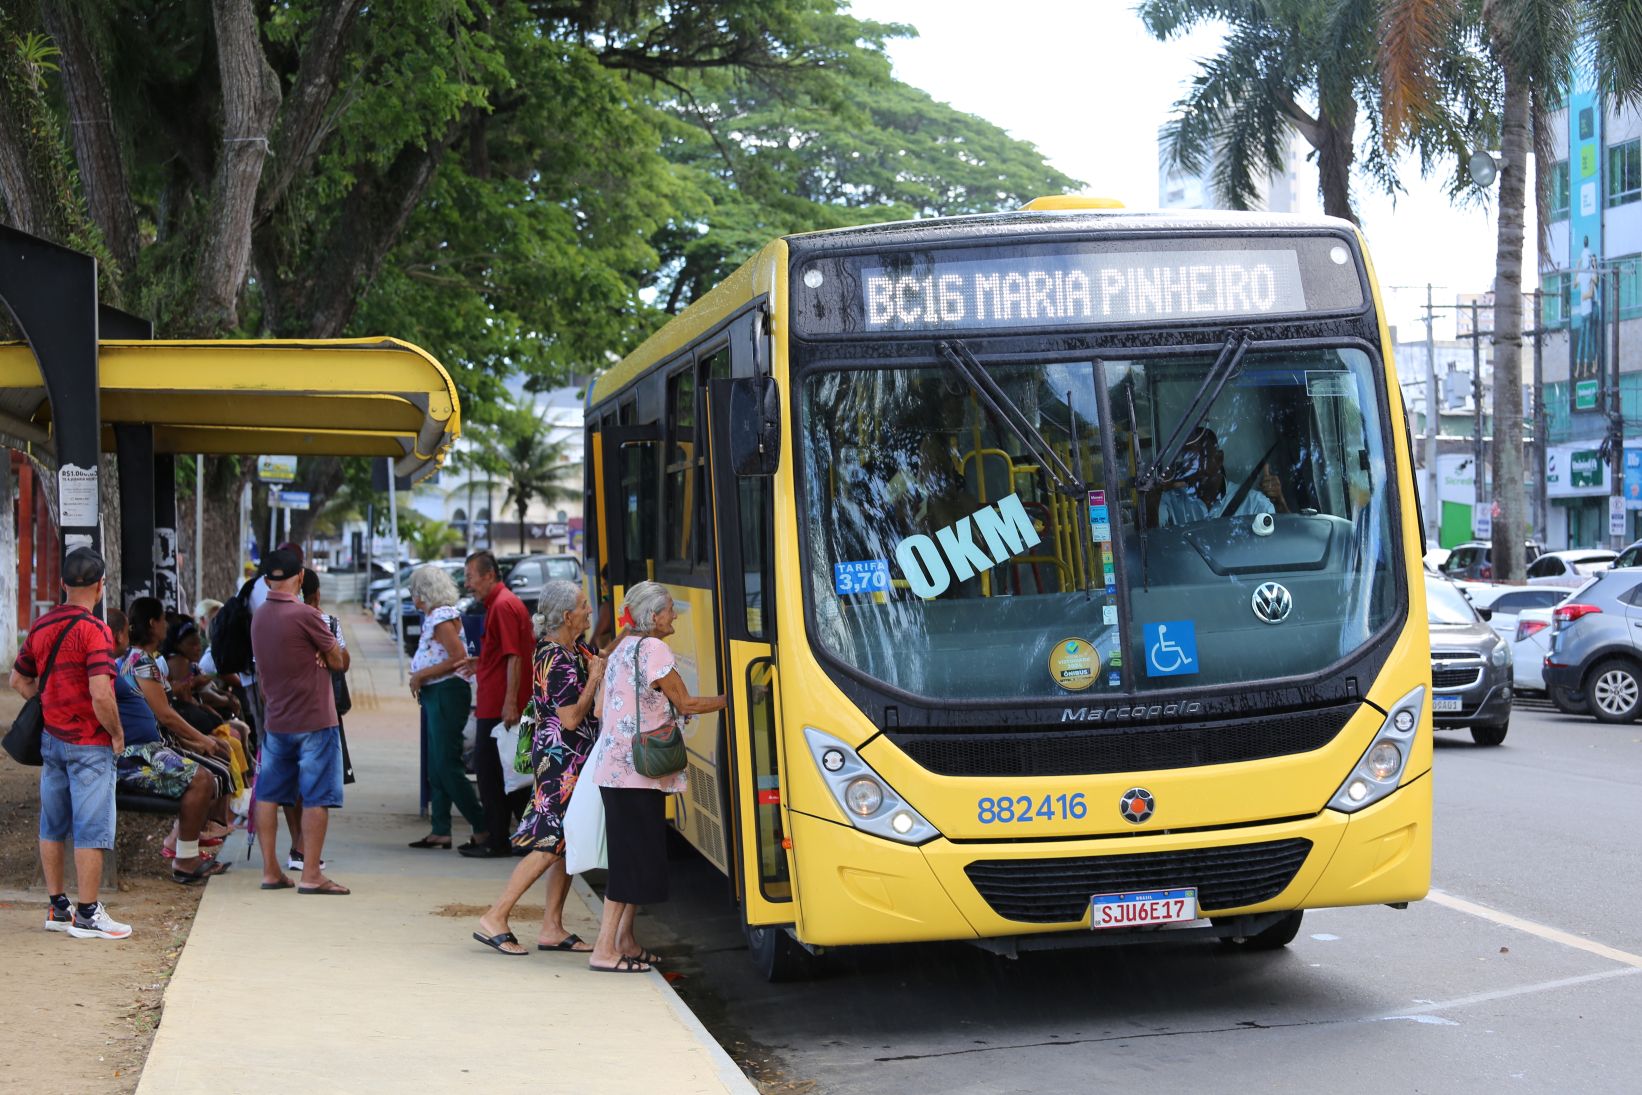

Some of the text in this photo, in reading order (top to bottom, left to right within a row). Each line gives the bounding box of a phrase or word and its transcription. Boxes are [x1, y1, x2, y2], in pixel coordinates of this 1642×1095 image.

[867, 263, 1276, 324] BC16 MARIA PINHEIRO
[838, 562, 885, 573] TARIFA
[839, 571, 886, 592] 3,70
[1063, 669, 1088, 677] ÔNIBUS
[1061, 700, 1200, 721] Marcopolo
[977, 792, 1087, 824] 882416
[1102, 900, 1184, 923] SJU6E17
